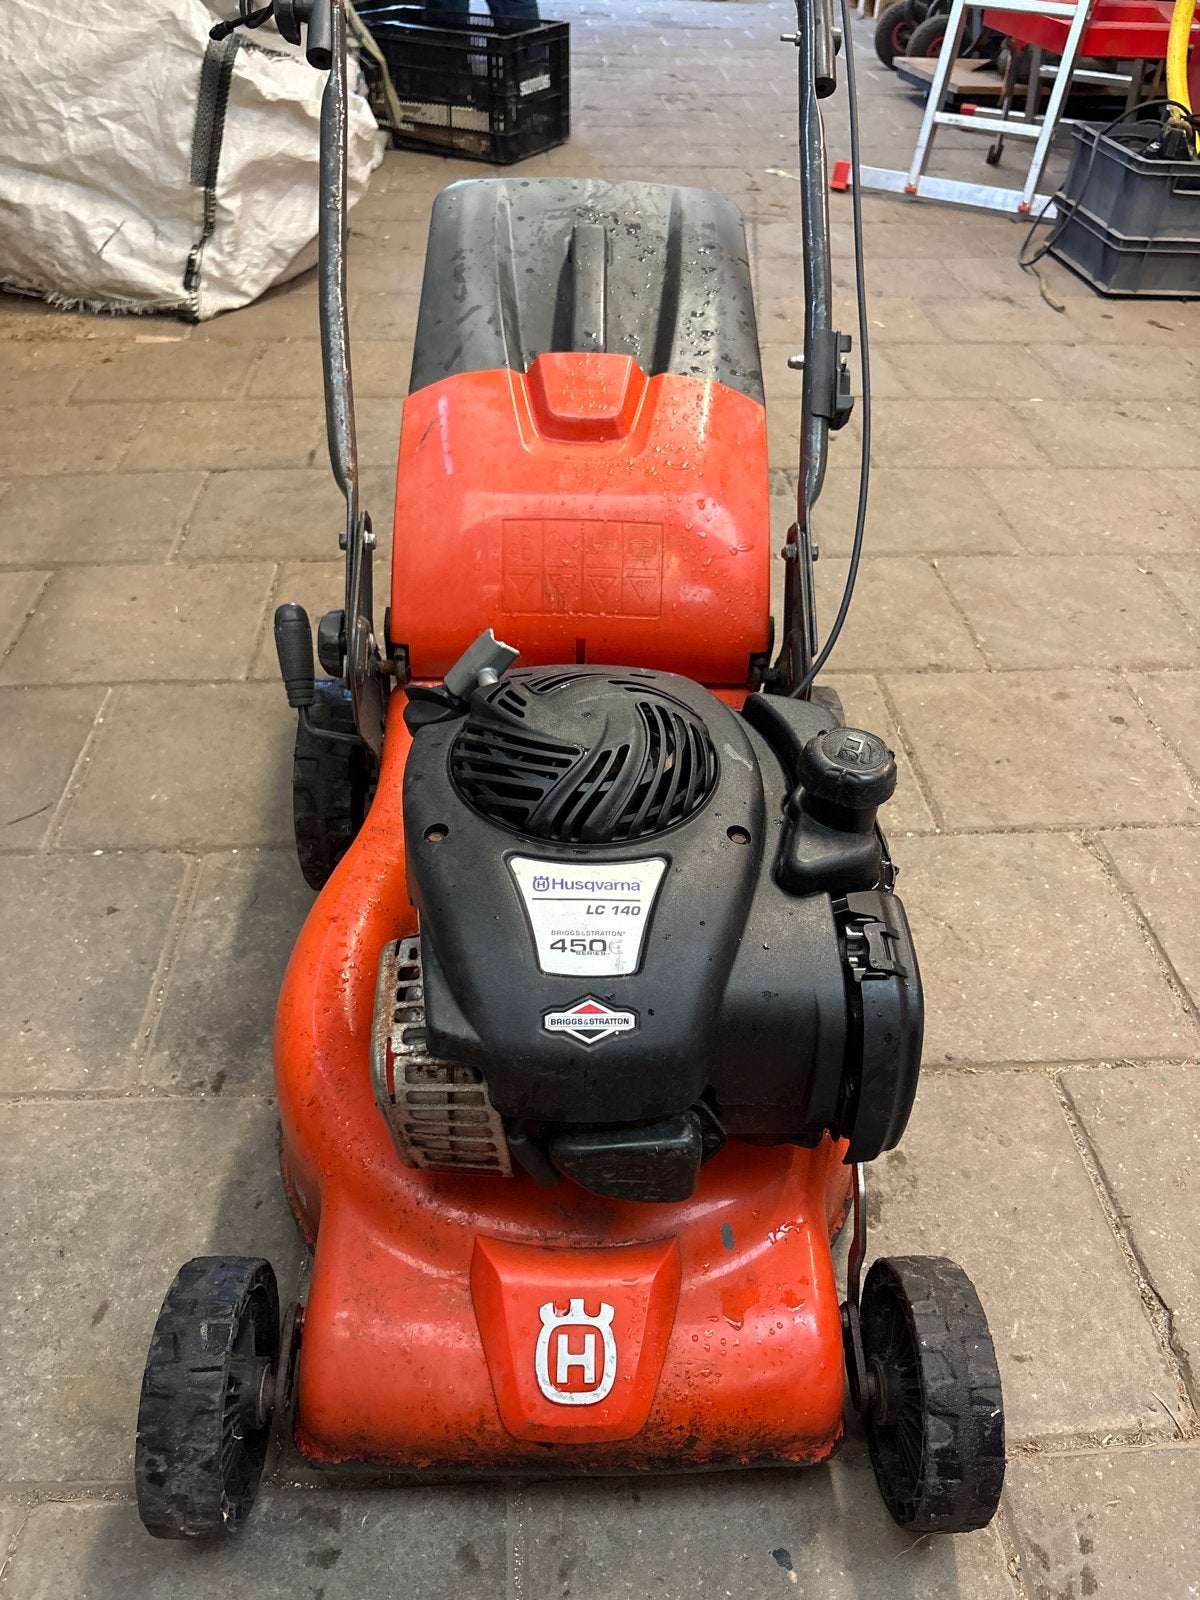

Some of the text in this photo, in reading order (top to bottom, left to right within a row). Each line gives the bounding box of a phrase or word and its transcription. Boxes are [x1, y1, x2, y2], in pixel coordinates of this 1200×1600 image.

[551, 878, 641, 892] Husqvarna
[586, 905, 641, 916] LC 140
[556, 1333, 596, 1384] H
